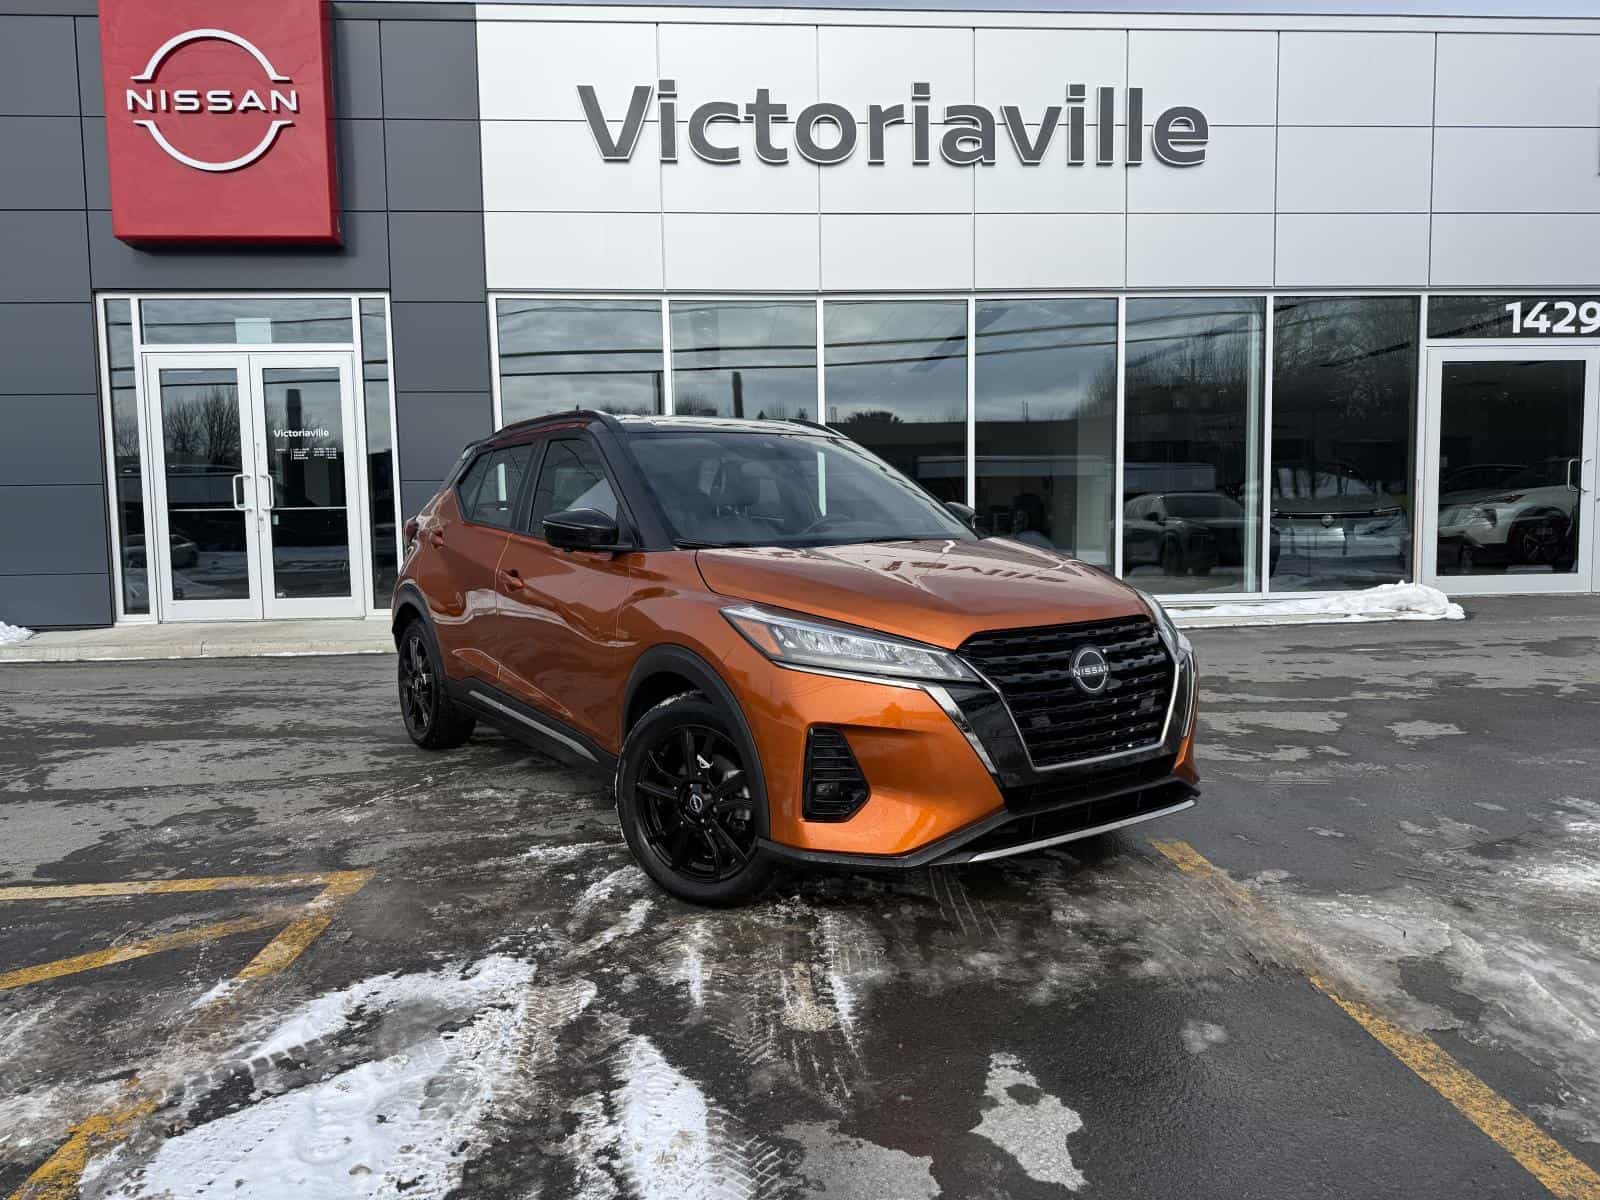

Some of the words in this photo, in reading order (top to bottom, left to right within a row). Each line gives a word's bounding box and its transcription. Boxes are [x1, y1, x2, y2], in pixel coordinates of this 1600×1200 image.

[126, 89, 298, 112] NISSAN
[576, 79, 1209, 166] Victoriaville
[1505, 301, 1600, 334] 1429
[273, 428, 330, 438] Victoriaville
[1073, 664, 1109, 678] NISSAN
